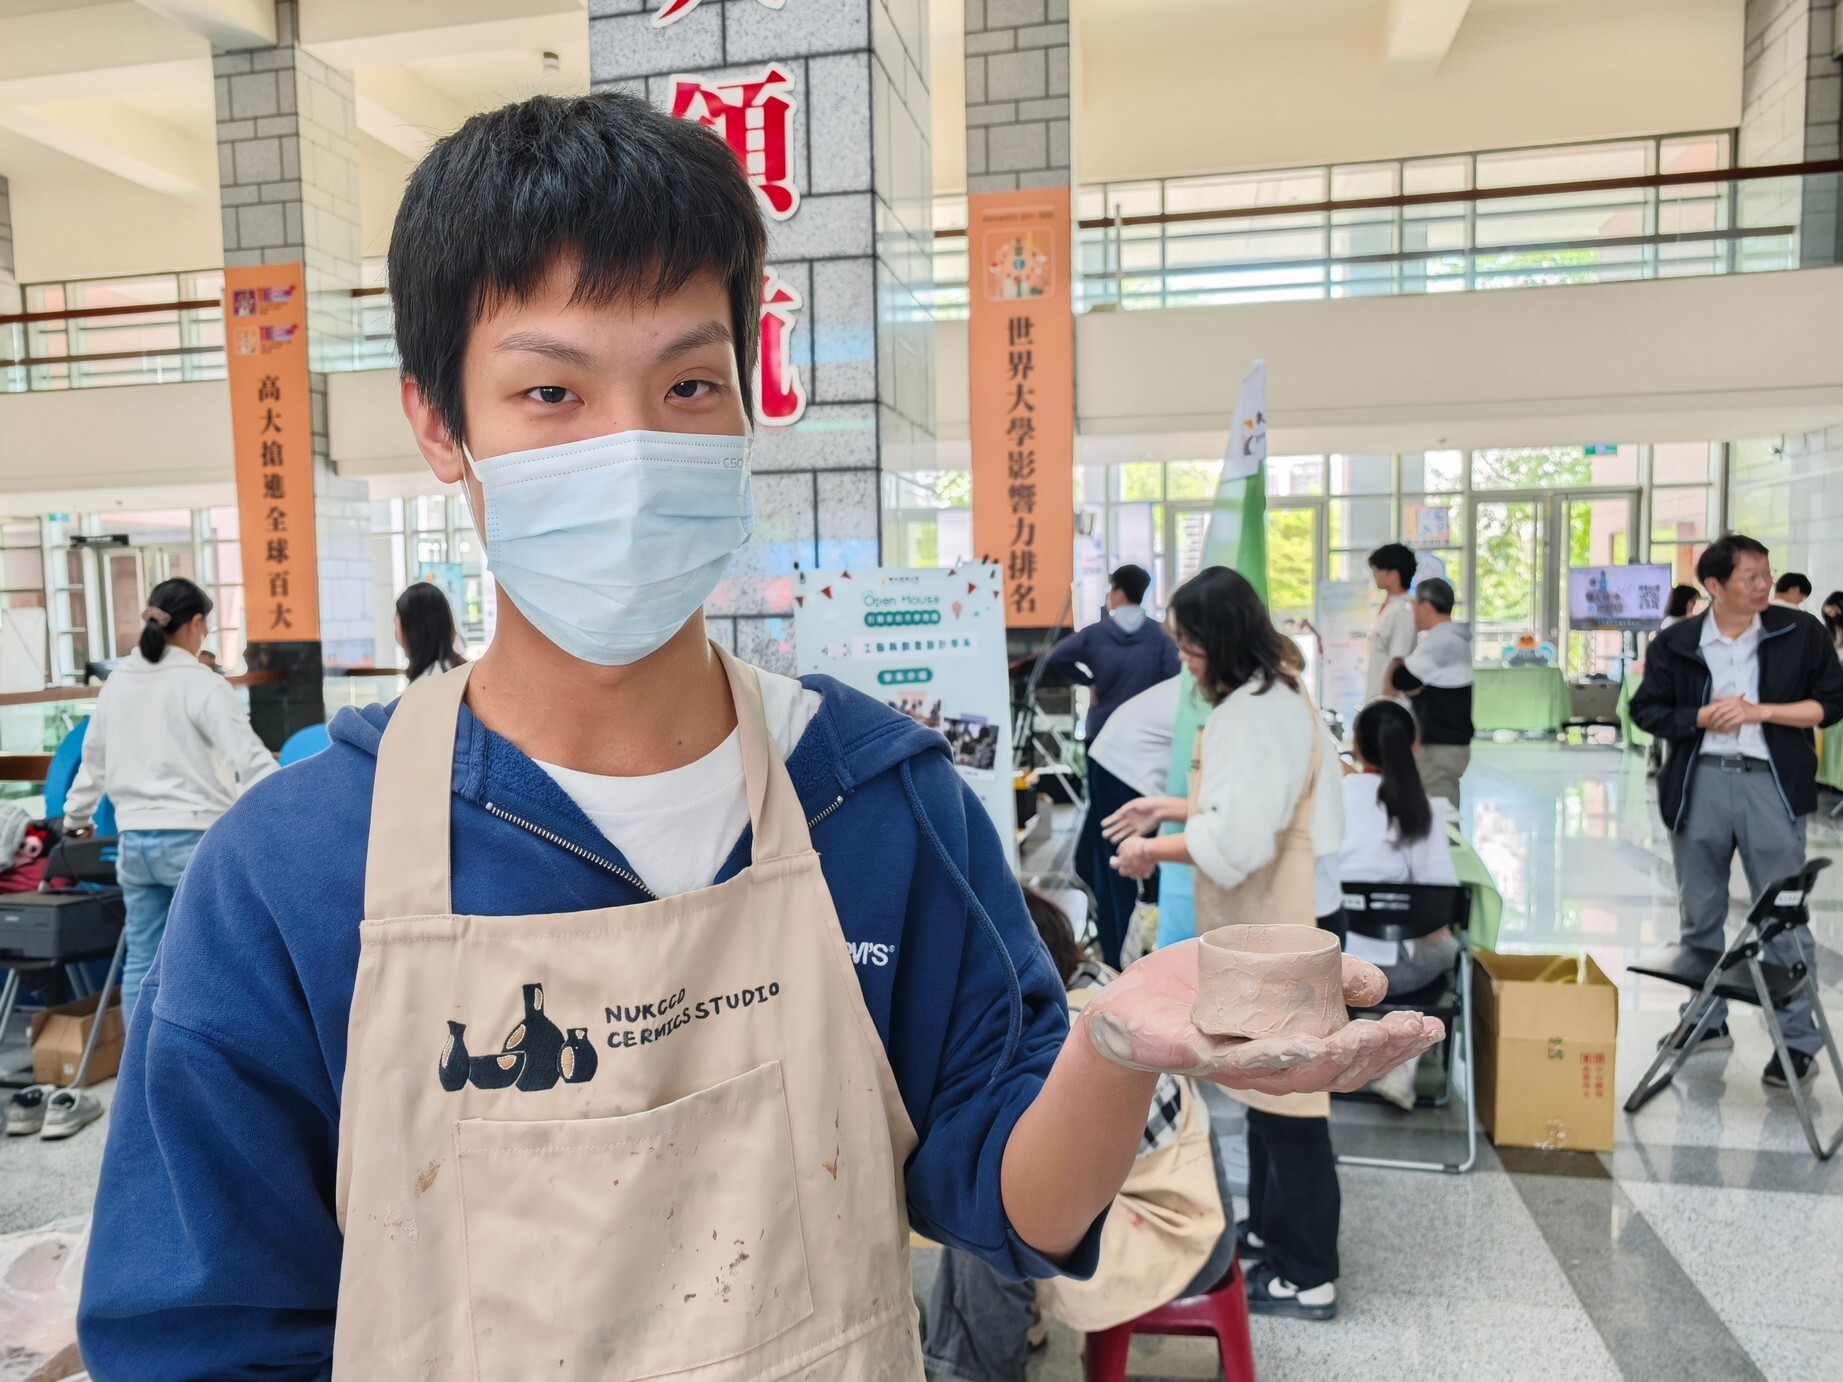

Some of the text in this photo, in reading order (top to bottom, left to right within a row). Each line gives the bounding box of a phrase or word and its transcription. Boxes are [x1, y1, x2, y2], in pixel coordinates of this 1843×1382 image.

[1006, 316, 1037, 614] 世界大學影響力排名
[258, 375, 292, 630] 高大搶進全球百大
[864, 593, 940, 607] Open House
[605, 988, 686, 1024] NUKCCD
[695, 982, 780, 1019] STUDIO
